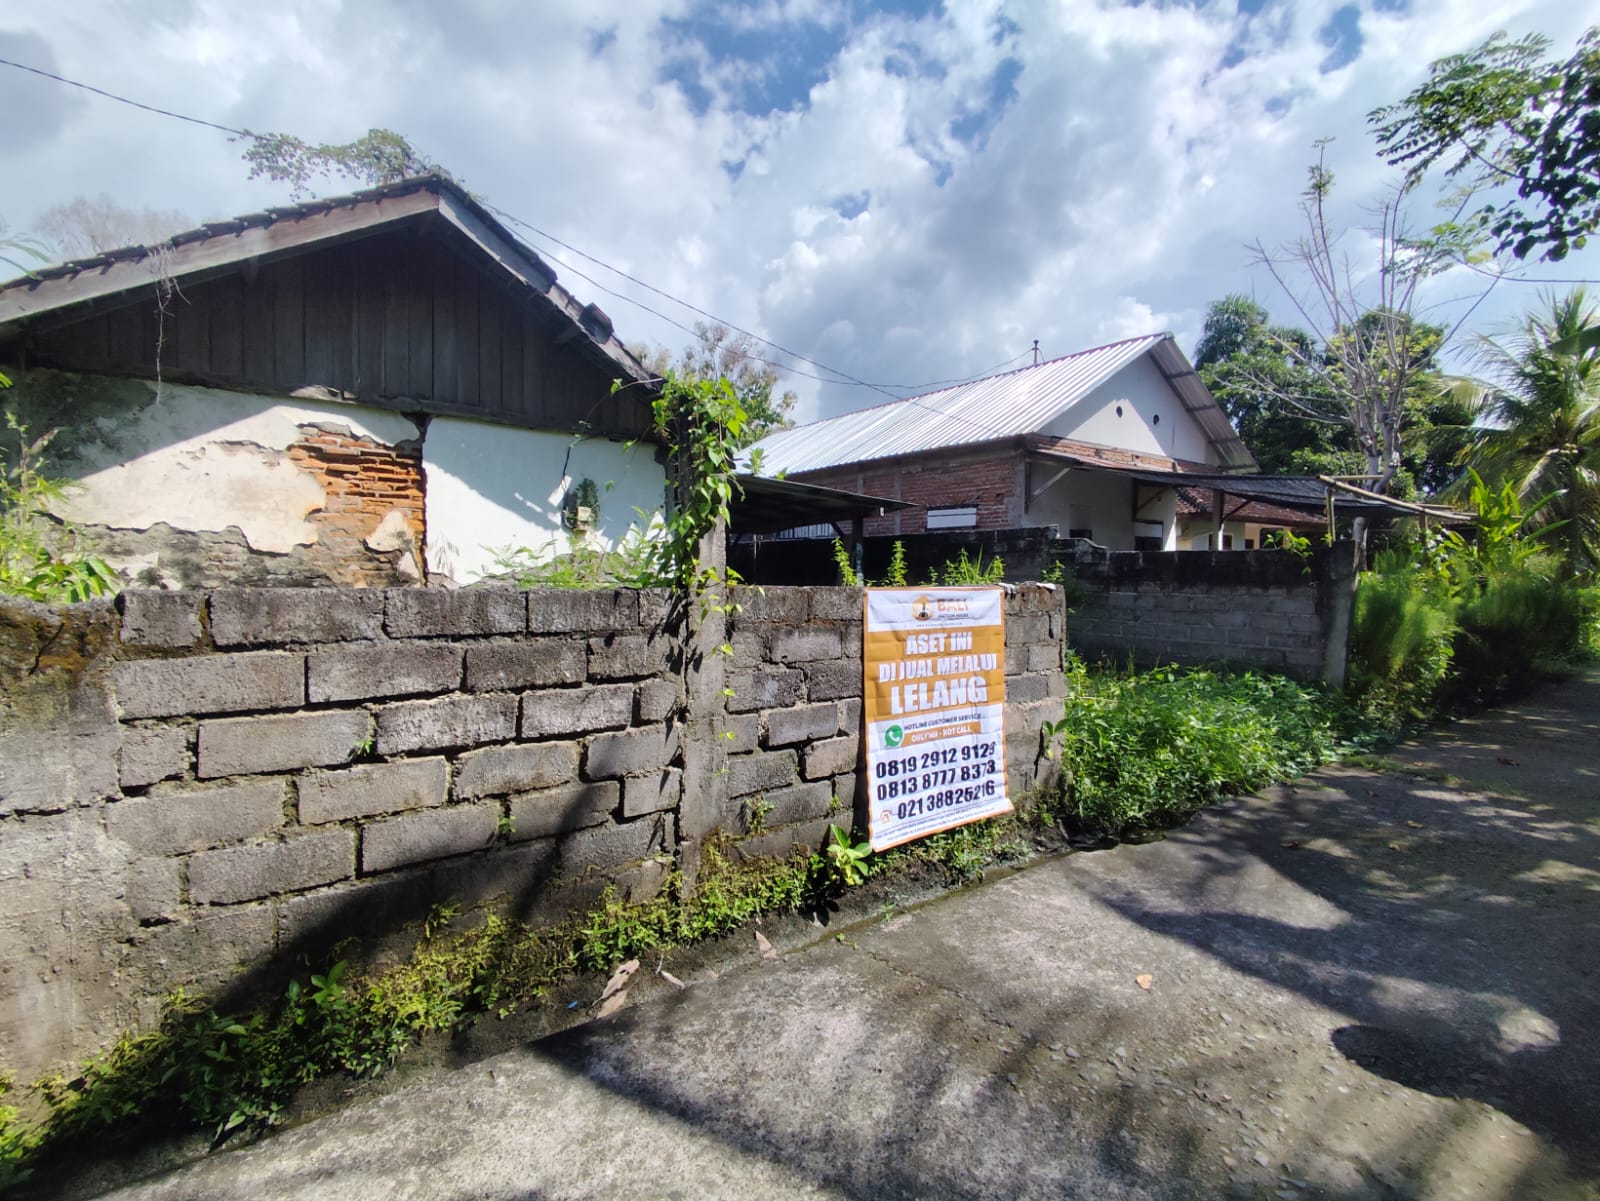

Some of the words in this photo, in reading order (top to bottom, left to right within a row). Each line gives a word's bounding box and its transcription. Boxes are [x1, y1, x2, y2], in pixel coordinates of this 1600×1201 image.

[936, 598, 968, 611] BALI
[906, 633, 947, 655] ASET
[950, 631, 973, 651] INI
[879, 662, 896, 683] DI
[899, 659, 934, 680] JUAL
[937, 653, 997, 676] MELALUI
[891, 676, 988, 715] LELANG
[904, 722, 927, 730] HOTLINE
[928, 716, 957, 726] CUSTOMER
[958, 713, 982, 721] SERVICE
[911, 733, 929, 742] ONLY
[942, 728, 956, 737] NOT
[956, 725, 971, 734] CALL
[876, 756, 917, 779] 0819
[921, 748, 957, 769] 2912
[877, 777, 918, 801] 0813
[922, 768, 956, 790] 8777
[961, 760, 996, 781] 8373
[897, 798, 923, 819] 021
[927, 780, 995, 812] 38825216
